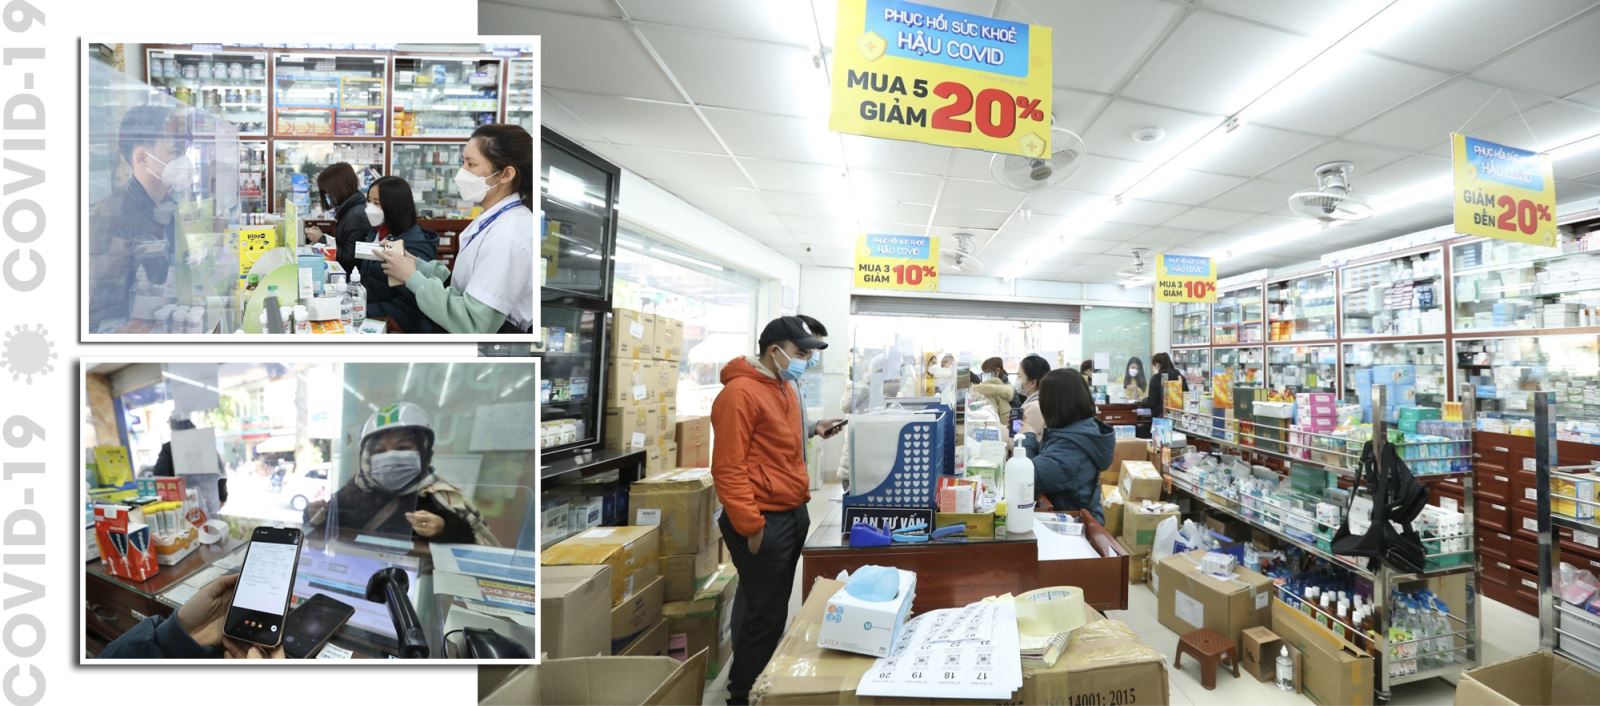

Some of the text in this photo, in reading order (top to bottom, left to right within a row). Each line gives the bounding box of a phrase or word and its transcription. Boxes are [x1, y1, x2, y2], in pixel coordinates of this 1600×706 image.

[884, 8, 923, 27] PHỤC
[926, 13, 948, 32] HỒI
[951, 17, 979, 37] SỨC
[897, 30, 1006, 66] HẬU COVID
[847, 69, 929, 98] MUA 5
[859, 98, 928, 128] GIẢM
[931, 81, 1044, 139] 20%
[1463, 187, 1552, 235] GIẢM 20%
[858, 263, 890, 273] MUA 3
[863, 272, 890, 283] GIẢM
[892, 264, 937, 286] 10%
[1184, 280, 1216, 299] 10%
[878, 671, 892, 680] 20
[911, 671, 923, 680] 19
[944, 671, 956, 680] 18
[976, 671, 988, 680] 17
[1109, 687, 1136, 706] 2015
